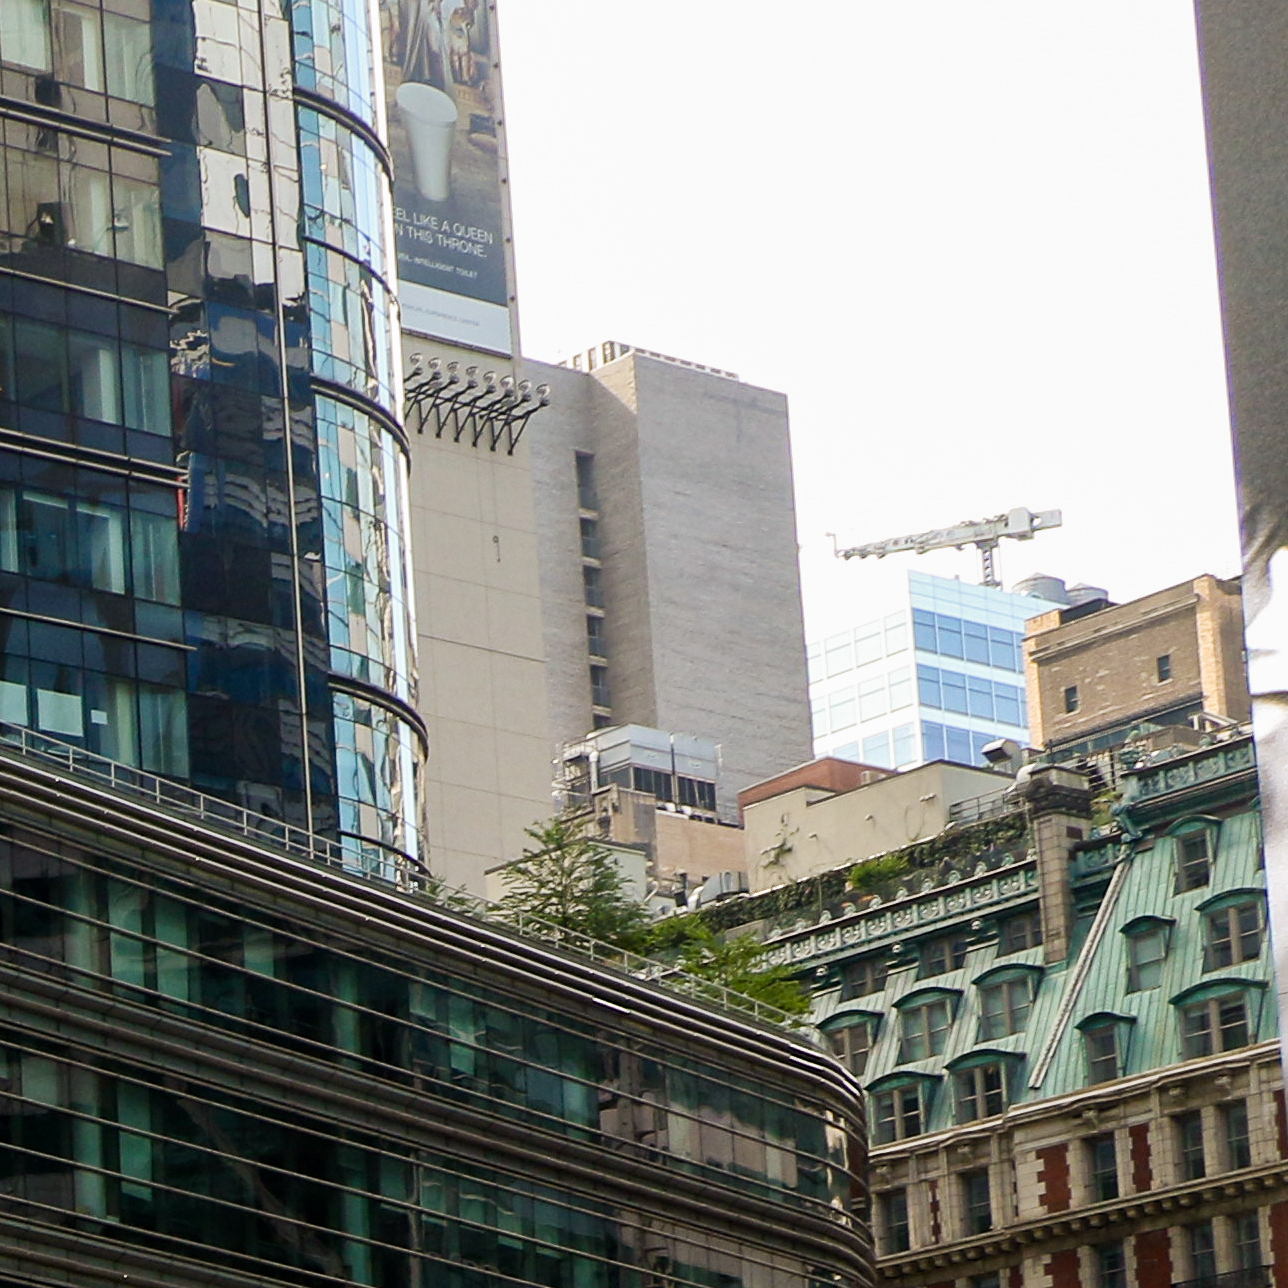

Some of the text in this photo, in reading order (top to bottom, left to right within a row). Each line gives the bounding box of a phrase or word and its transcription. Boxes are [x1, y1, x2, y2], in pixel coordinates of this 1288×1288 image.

[406, 225, 434, 245] THIS
[436, 232, 488, 258] THRONE.
[413, 212, 439, 230] LIKE
[441, 220, 451, 234] A
[453, 222, 493, 245] QUEEN
